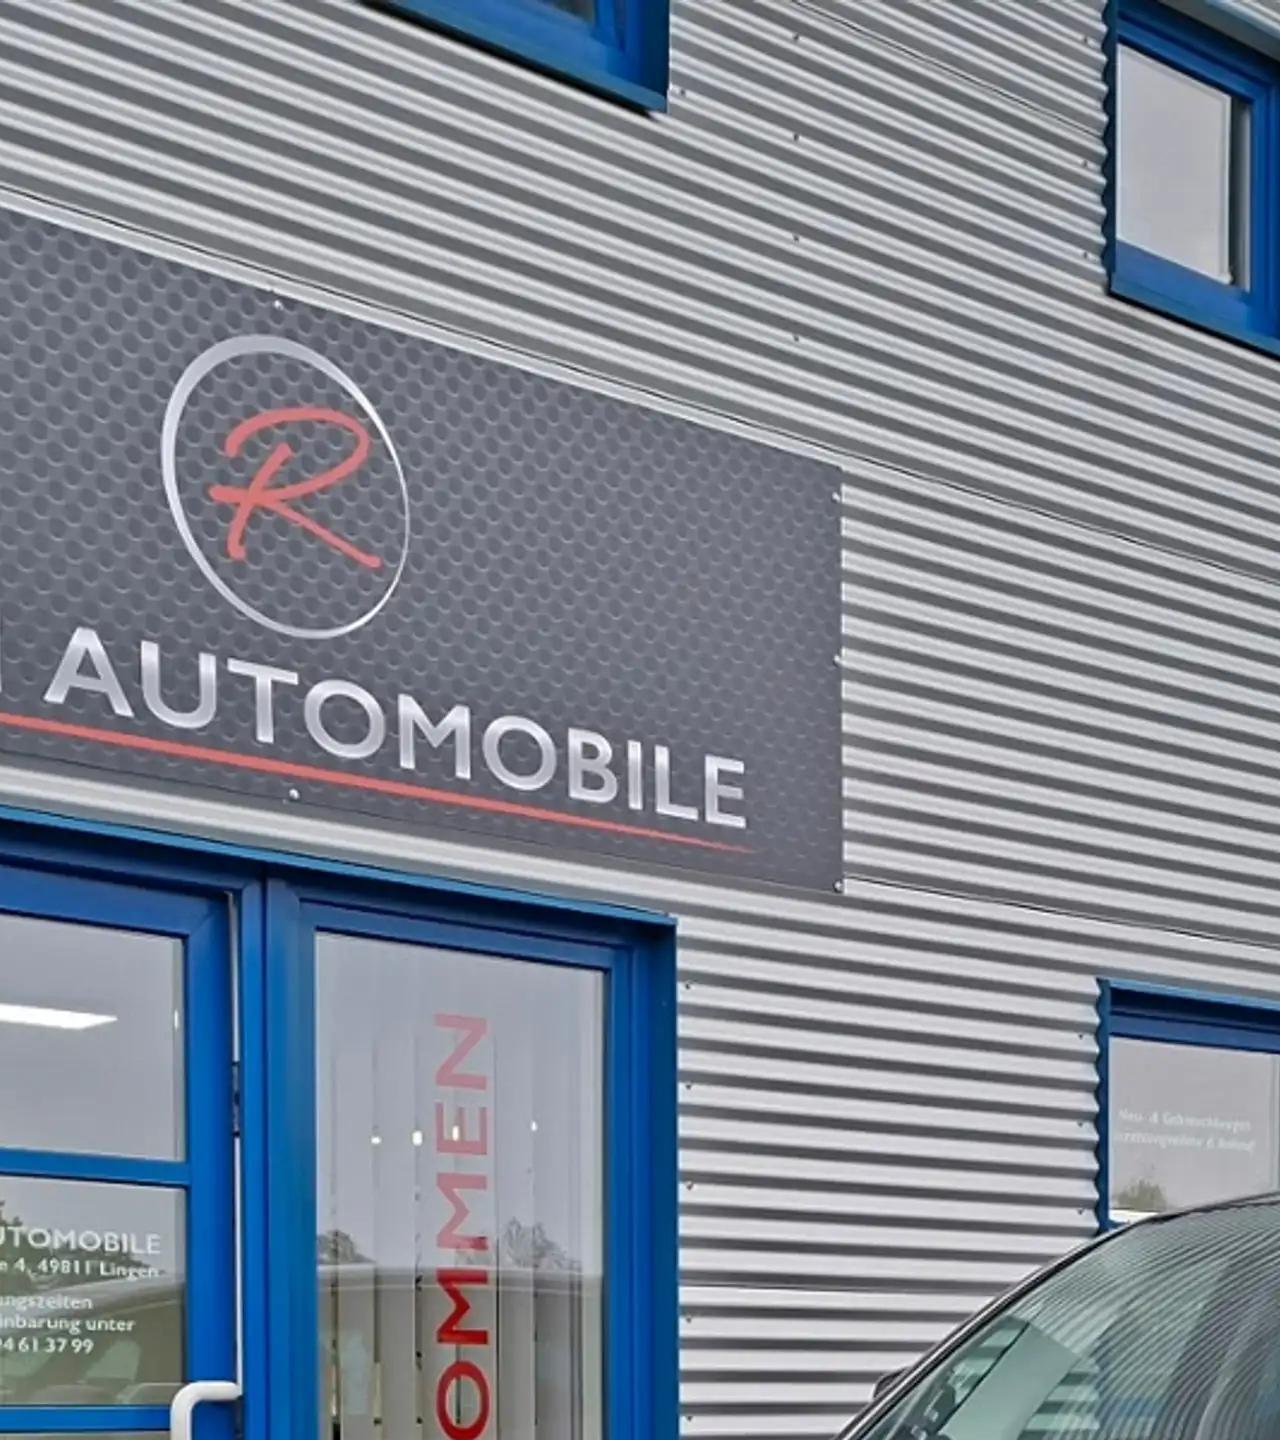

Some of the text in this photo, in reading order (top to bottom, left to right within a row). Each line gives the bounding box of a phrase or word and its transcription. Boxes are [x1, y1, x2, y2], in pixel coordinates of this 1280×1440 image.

[207, 406, 384, 569] R
[43, 626, 747, 829] AUTOMOBILE
[37, 1257, 92, 1276] 49811
[100, 1261, 159, 1281] Lingen
[85, 1317, 137, 1333] unter
[18, 1336, 39, 1352] 61
[46, 1337, 69, 1353] 37
[70, 1338, 94, 1355] 99
